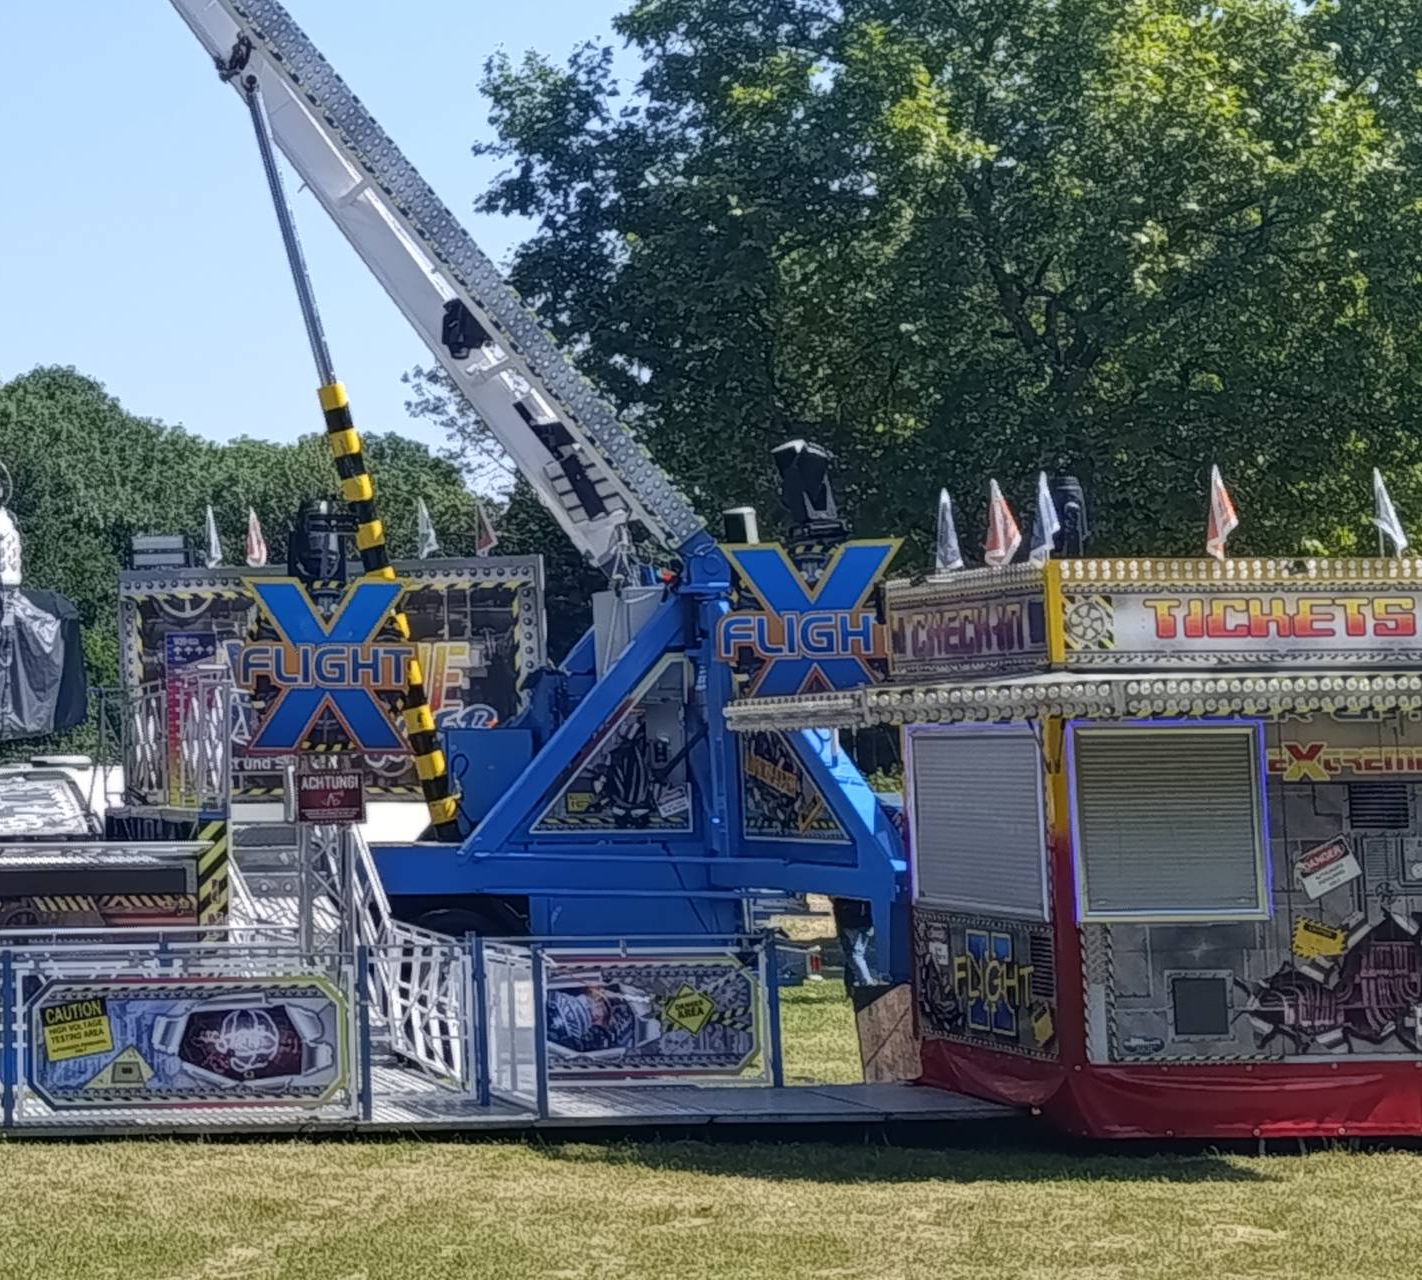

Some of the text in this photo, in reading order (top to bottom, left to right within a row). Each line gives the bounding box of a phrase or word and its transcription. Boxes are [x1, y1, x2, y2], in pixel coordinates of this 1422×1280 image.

[720, 612, 884, 660] FLIGH
[1143, 597, 1416, 638] TICKETS
[240, 645, 415, 687] FLIGHT
[953, 955, 1035, 1007] FLIGHT
[45, 1000, 102, 1024] CAUTION
